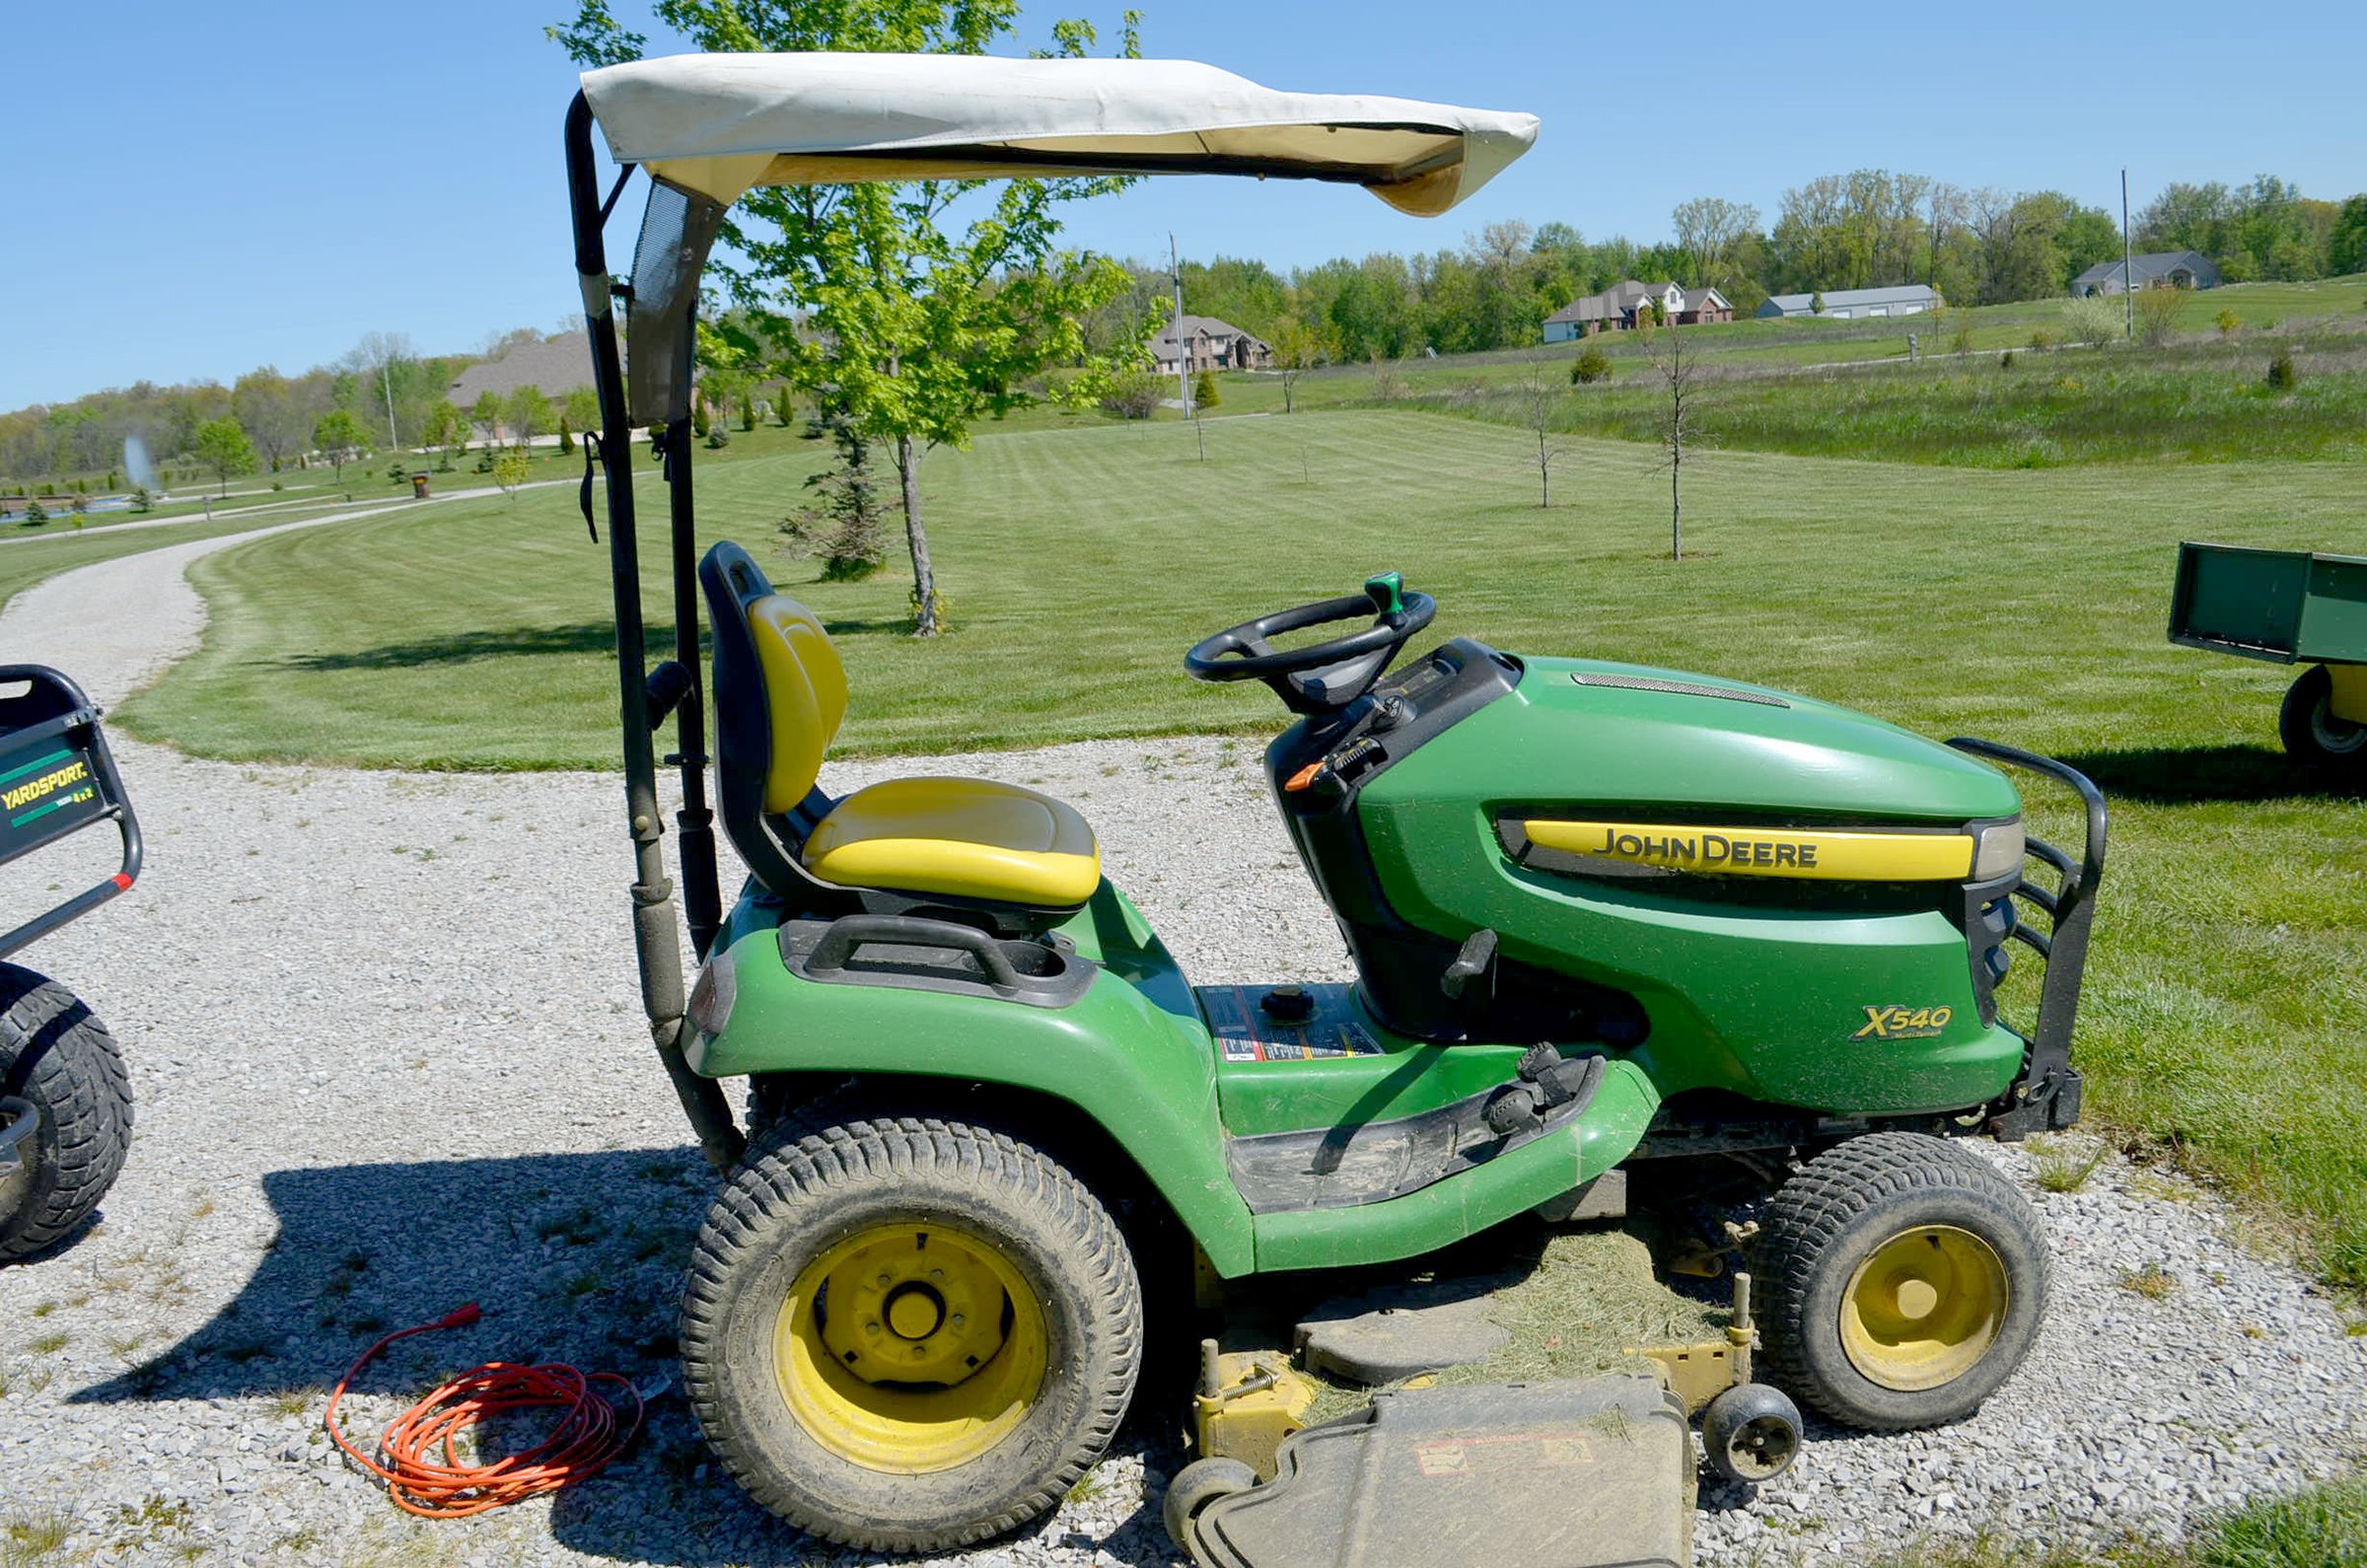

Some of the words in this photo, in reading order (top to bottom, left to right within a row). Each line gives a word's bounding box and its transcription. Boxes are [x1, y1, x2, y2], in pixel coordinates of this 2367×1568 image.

[1593, 827, 1695, 860] JOHN
[1701, 834, 1818, 868] DEERE
[1854, 1007, 1952, 1036] X540
